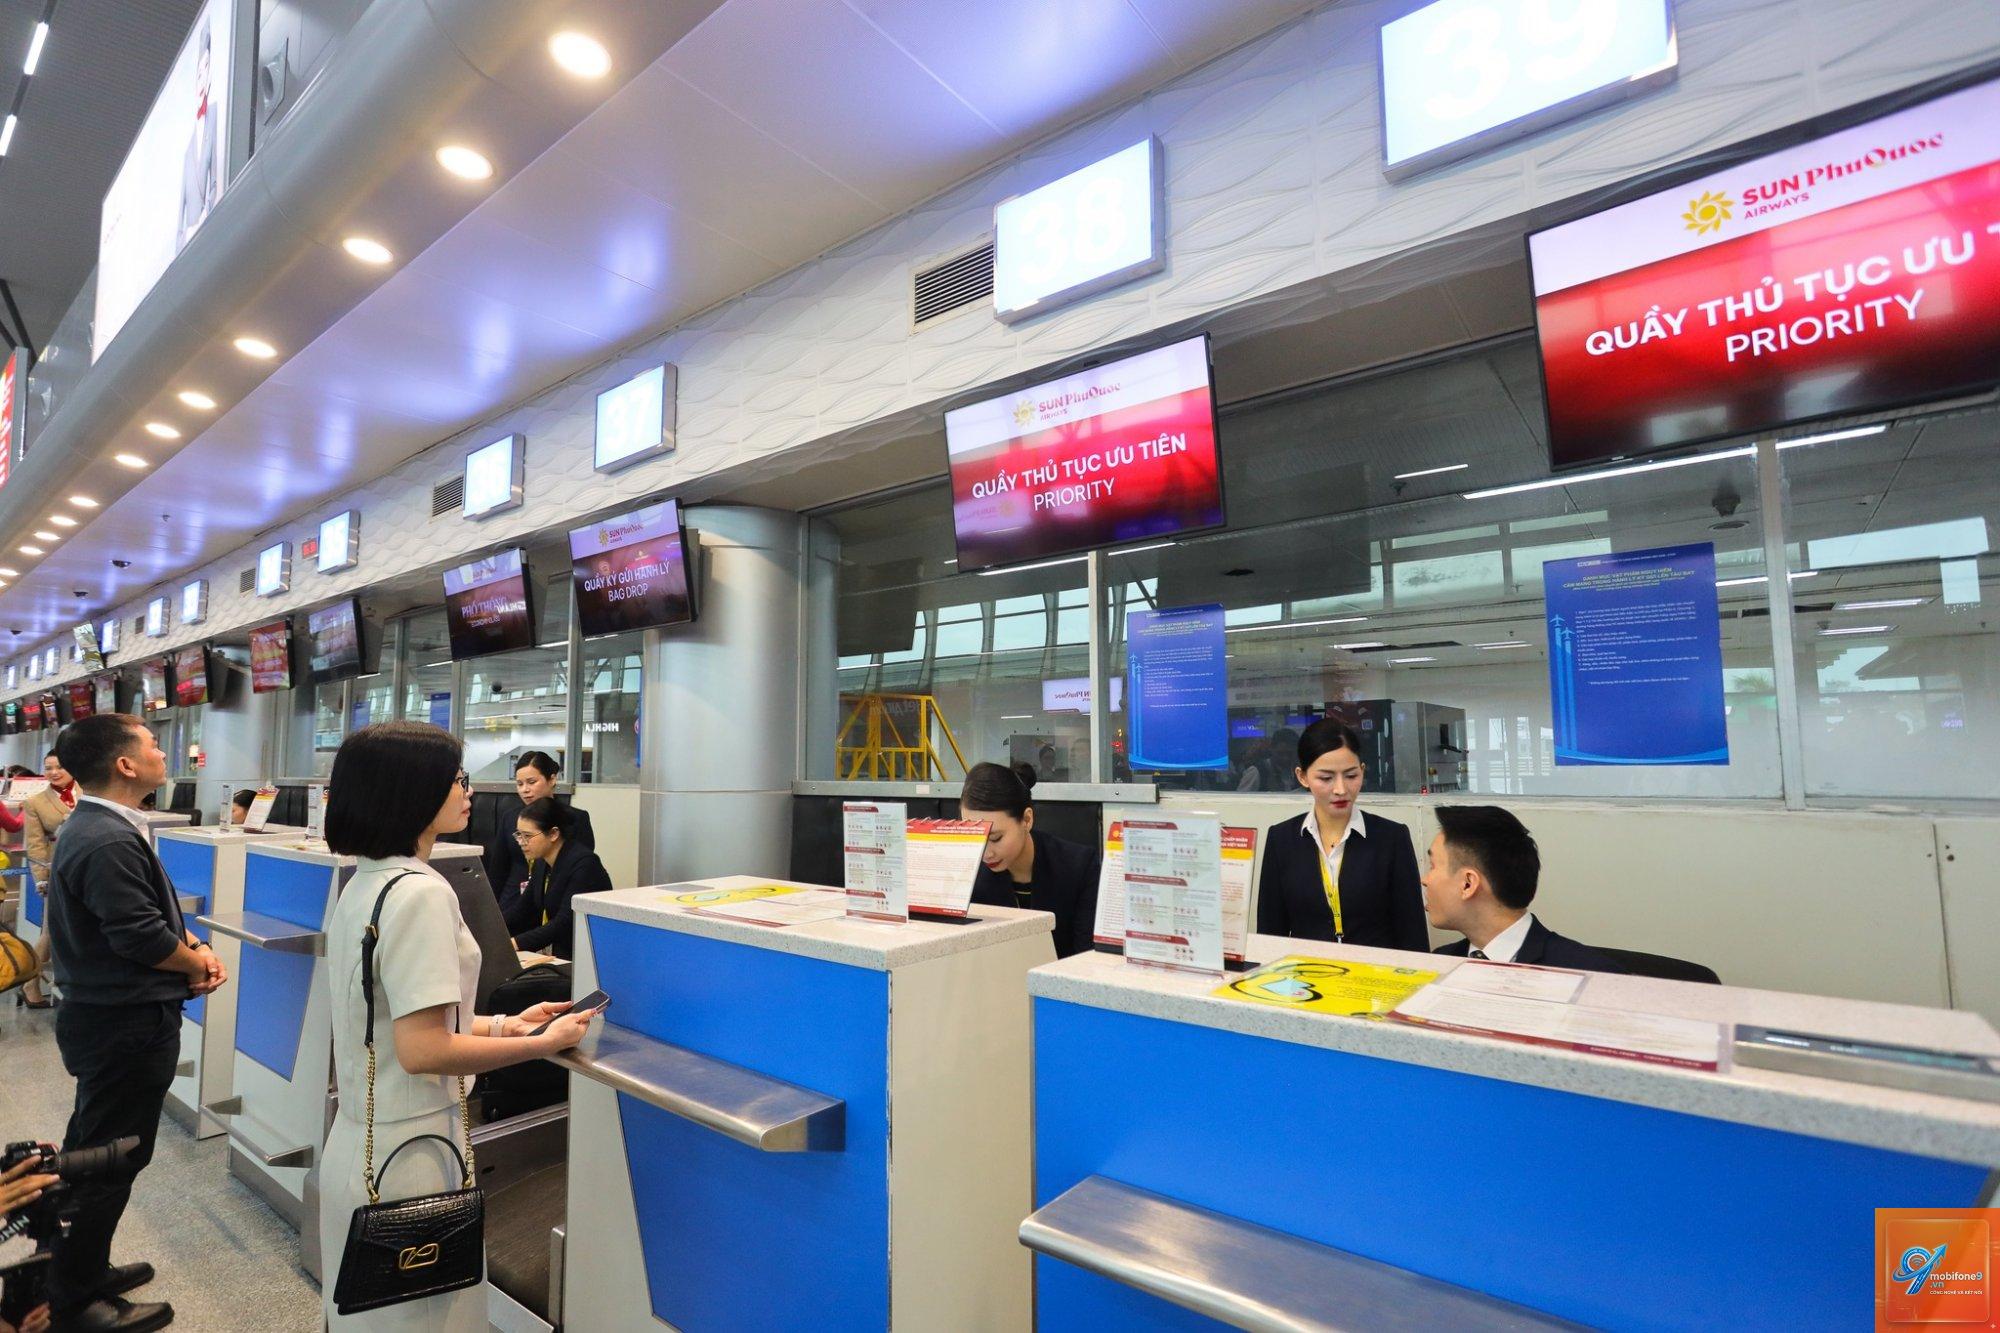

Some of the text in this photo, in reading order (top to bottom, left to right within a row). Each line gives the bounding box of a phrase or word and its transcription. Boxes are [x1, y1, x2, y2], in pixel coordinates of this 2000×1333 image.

[1422, 0, 1619, 119] 39
[1742, 174, 1801, 207] SUN
[1744, 192, 1810, 220] AIRWAYS
[1019, 177, 1128, 285] 38
[1585, 229, 1976, 357] QUẦY THỦ TỤC ƯU
[1725, 288, 1925, 363] PRIORITY
[1038, 396, 1064, 412] SUN
[971, 432, 1187, 499] QUẦY THỦ TỤC ƯU TIÊN
[1033, 477, 1116, 511] PRIORITY
[660, 557, 670, 575] LÝ
[608, 583, 648, 602] BAG DROP
